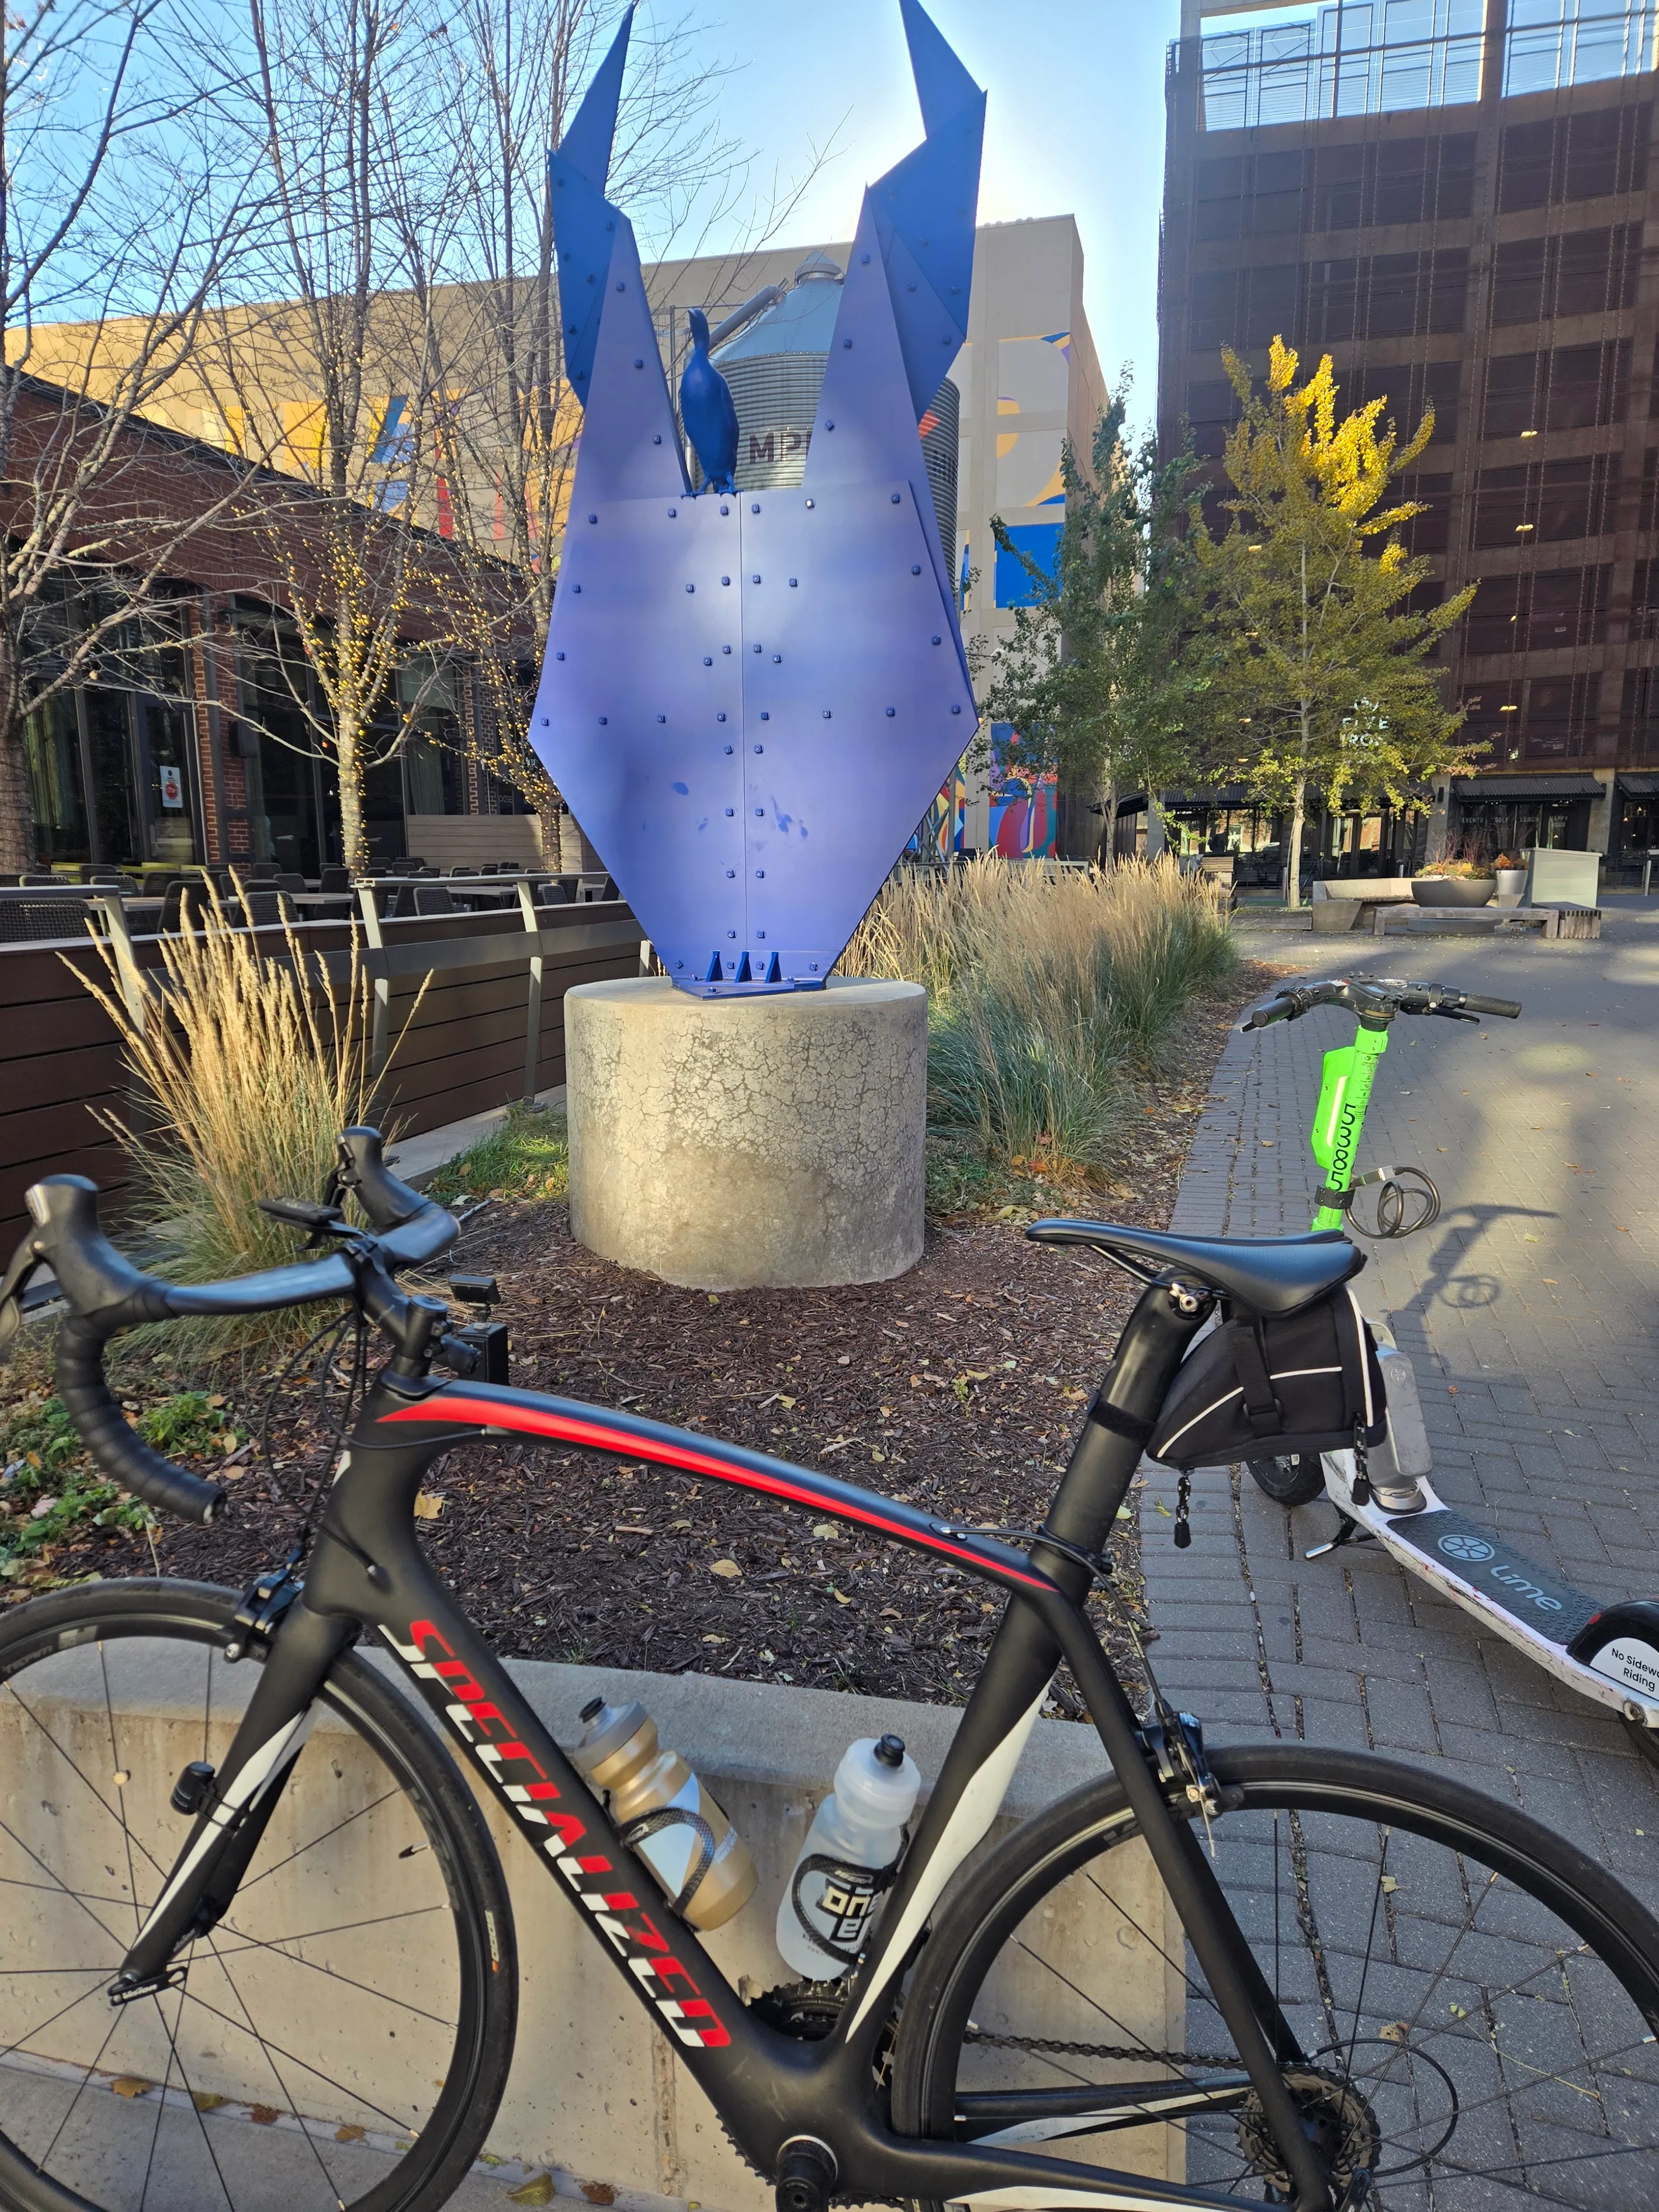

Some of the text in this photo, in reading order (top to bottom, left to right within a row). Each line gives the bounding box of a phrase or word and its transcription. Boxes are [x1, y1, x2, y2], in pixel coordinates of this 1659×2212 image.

[1328, 1103, 1356, 1192] 5385
[1611, 1647, 1625, 1660] No
[1623, 1667, 1656, 1692] Riding
[377, 1620, 731, 2047] SPECIALIZED
